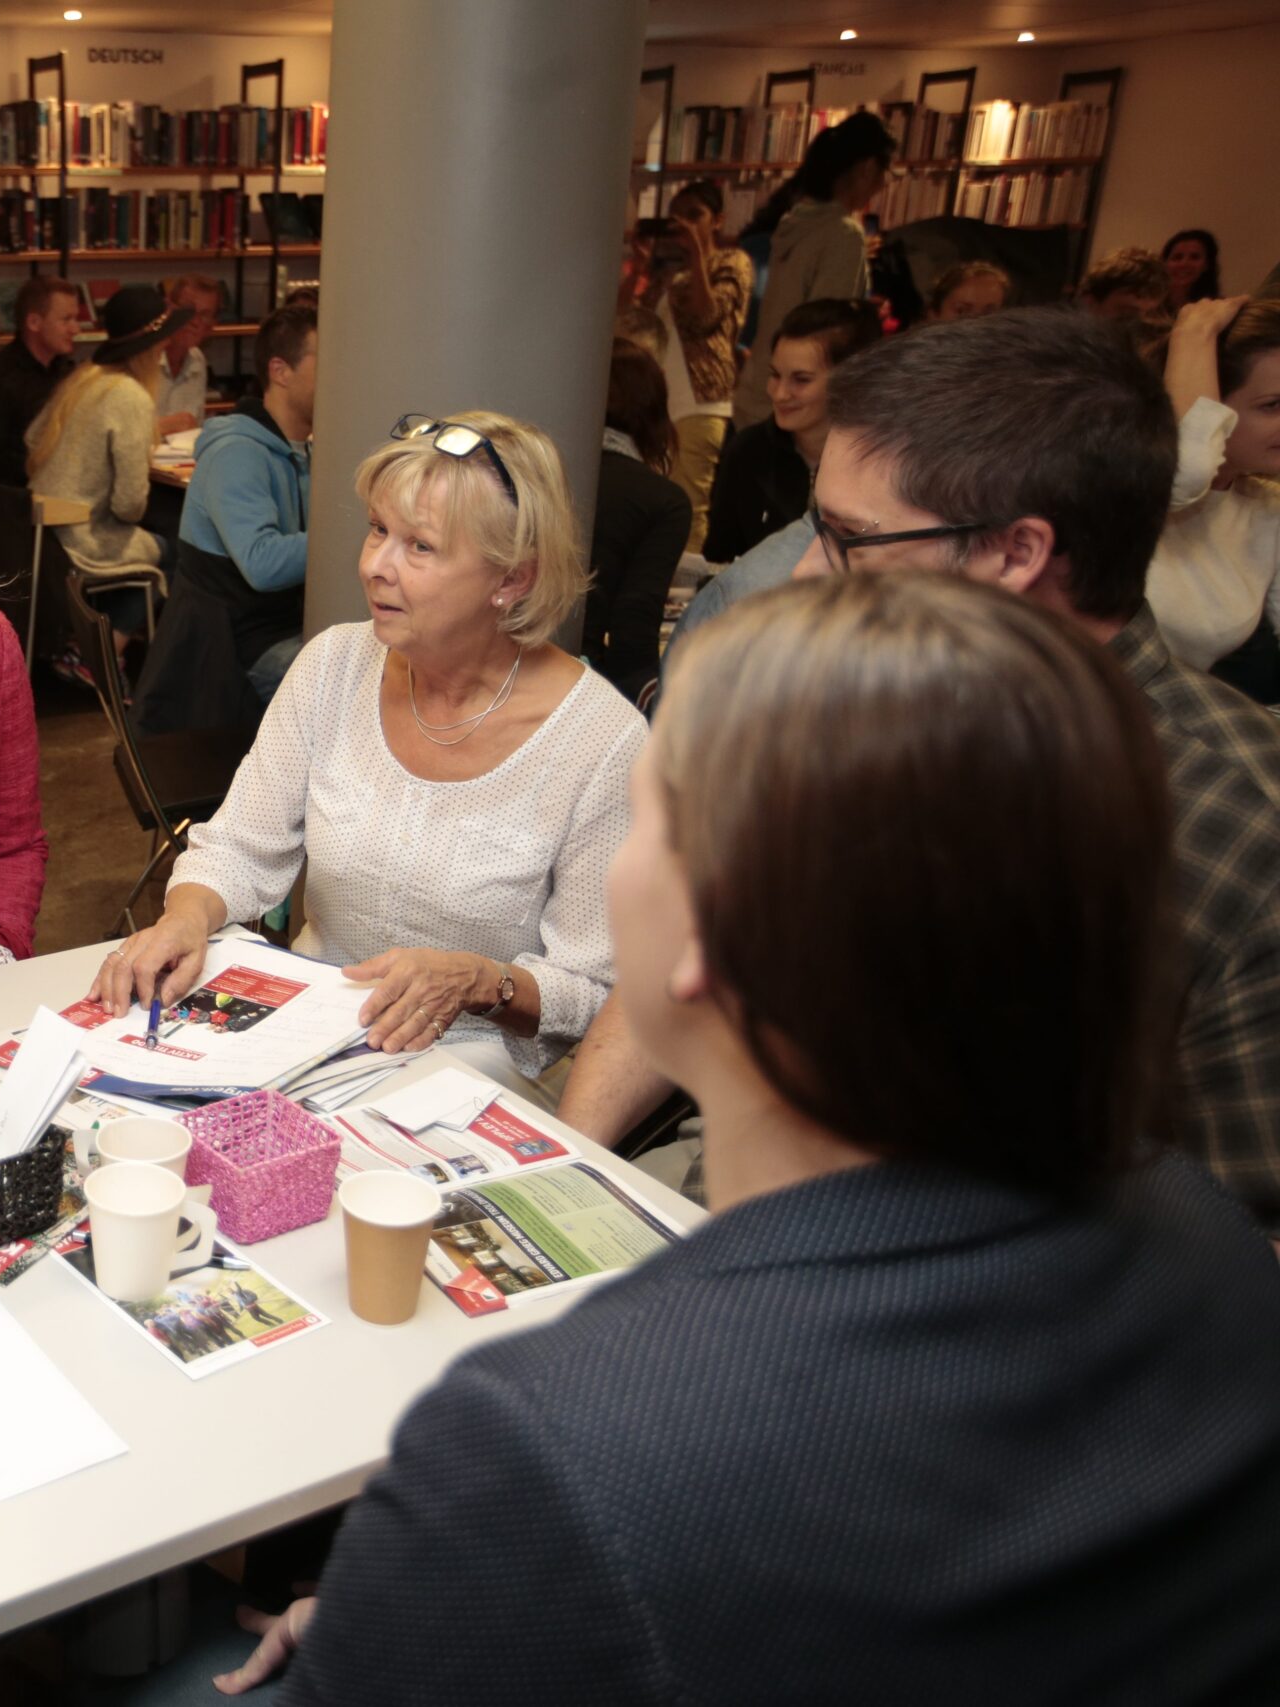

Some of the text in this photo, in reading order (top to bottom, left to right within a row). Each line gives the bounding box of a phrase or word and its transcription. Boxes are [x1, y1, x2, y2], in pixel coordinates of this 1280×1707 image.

[87, 47, 164, 64] DEUTSCH
[495, 1214, 525, 1242] MUSEUM
[518, 1238, 541, 1257] GRIEG
[535, 1254, 565, 1279] EDVARD
